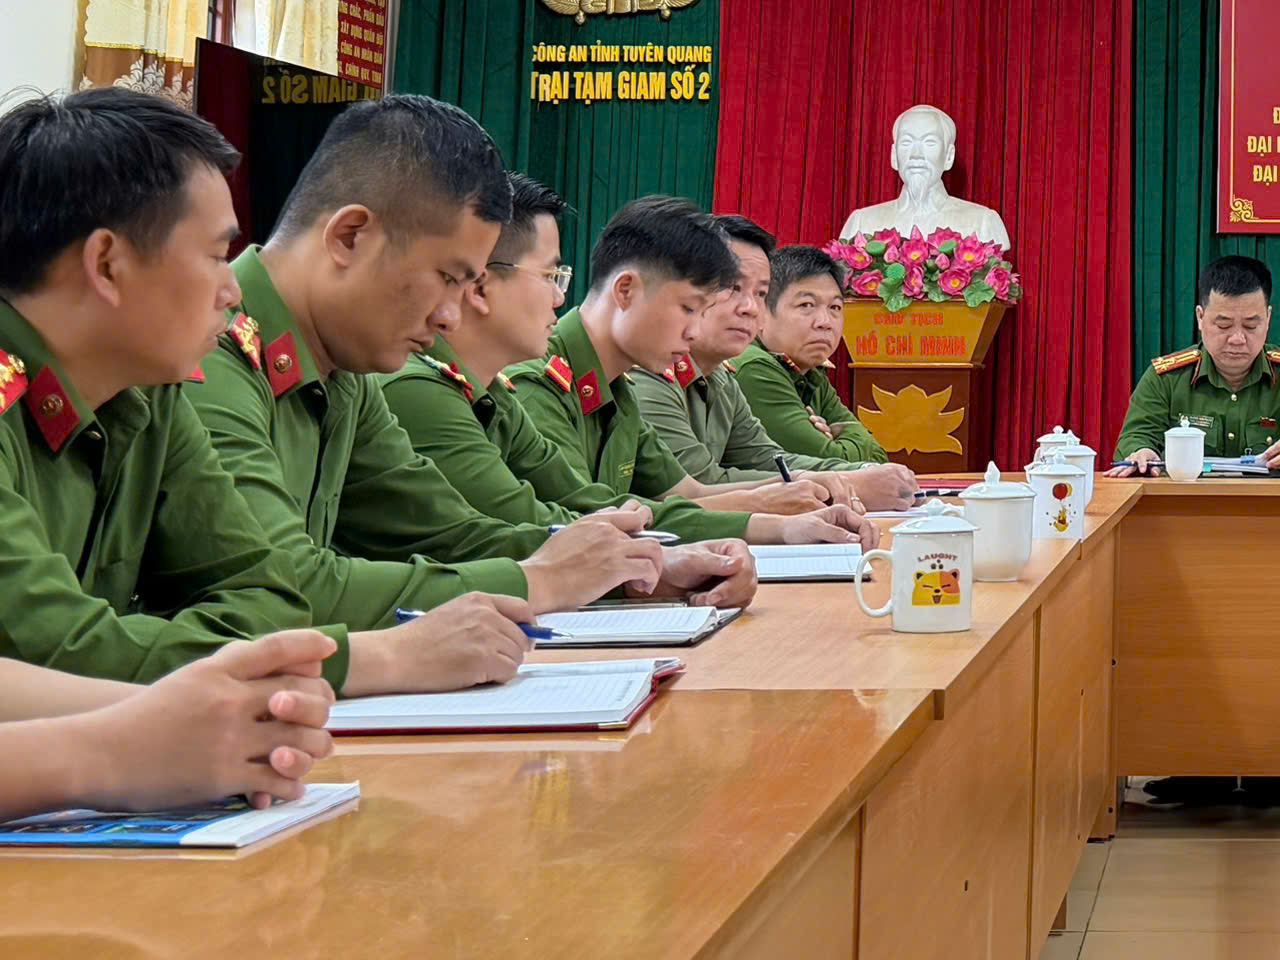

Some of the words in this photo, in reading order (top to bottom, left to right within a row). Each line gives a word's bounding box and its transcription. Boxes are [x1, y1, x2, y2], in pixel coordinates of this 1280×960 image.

[568, 45, 588, 62] AN
[590, 40, 620, 62] TỈNH
[623, 42, 664, 62] TUYÊN
[667, 45, 712, 64] QUANG
[531, 71, 570, 104] TRẠI
[573, 71, 612, 104] TẠM
[617, 71, 666, 100] GIAM
[670, 64, 696, 100] SỐ
[698, 72, 710, 100] 2
[1247, 135, 1272, 157] ĐẠI
[1253, 165, 1277, 186] ĐẠI
[917, 553, 958, 563] LAUGHT
